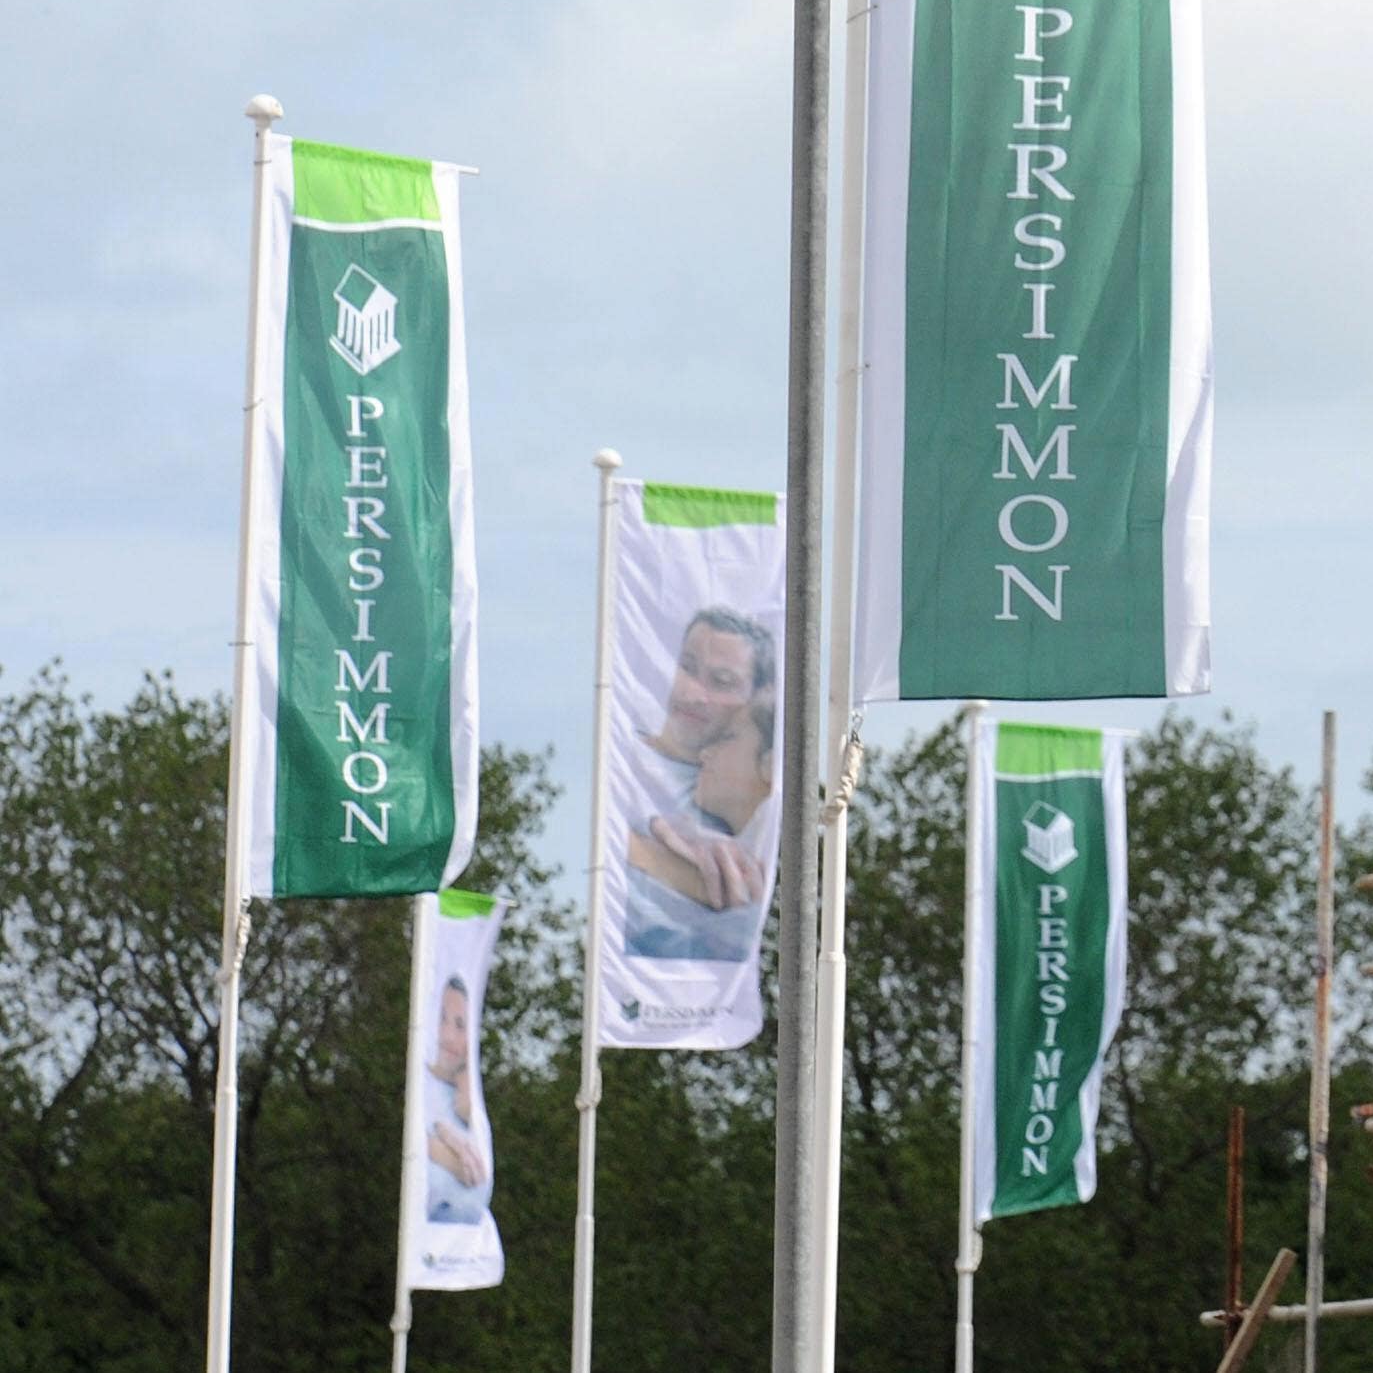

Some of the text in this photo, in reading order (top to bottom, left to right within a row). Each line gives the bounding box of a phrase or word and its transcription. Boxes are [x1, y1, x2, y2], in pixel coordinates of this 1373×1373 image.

[993, 4, 1078, 622] PERSIMMON
[334, 394, 392, 845] PERSIMMON
[1021, 884, 1069, 1177] PERSIMMON
